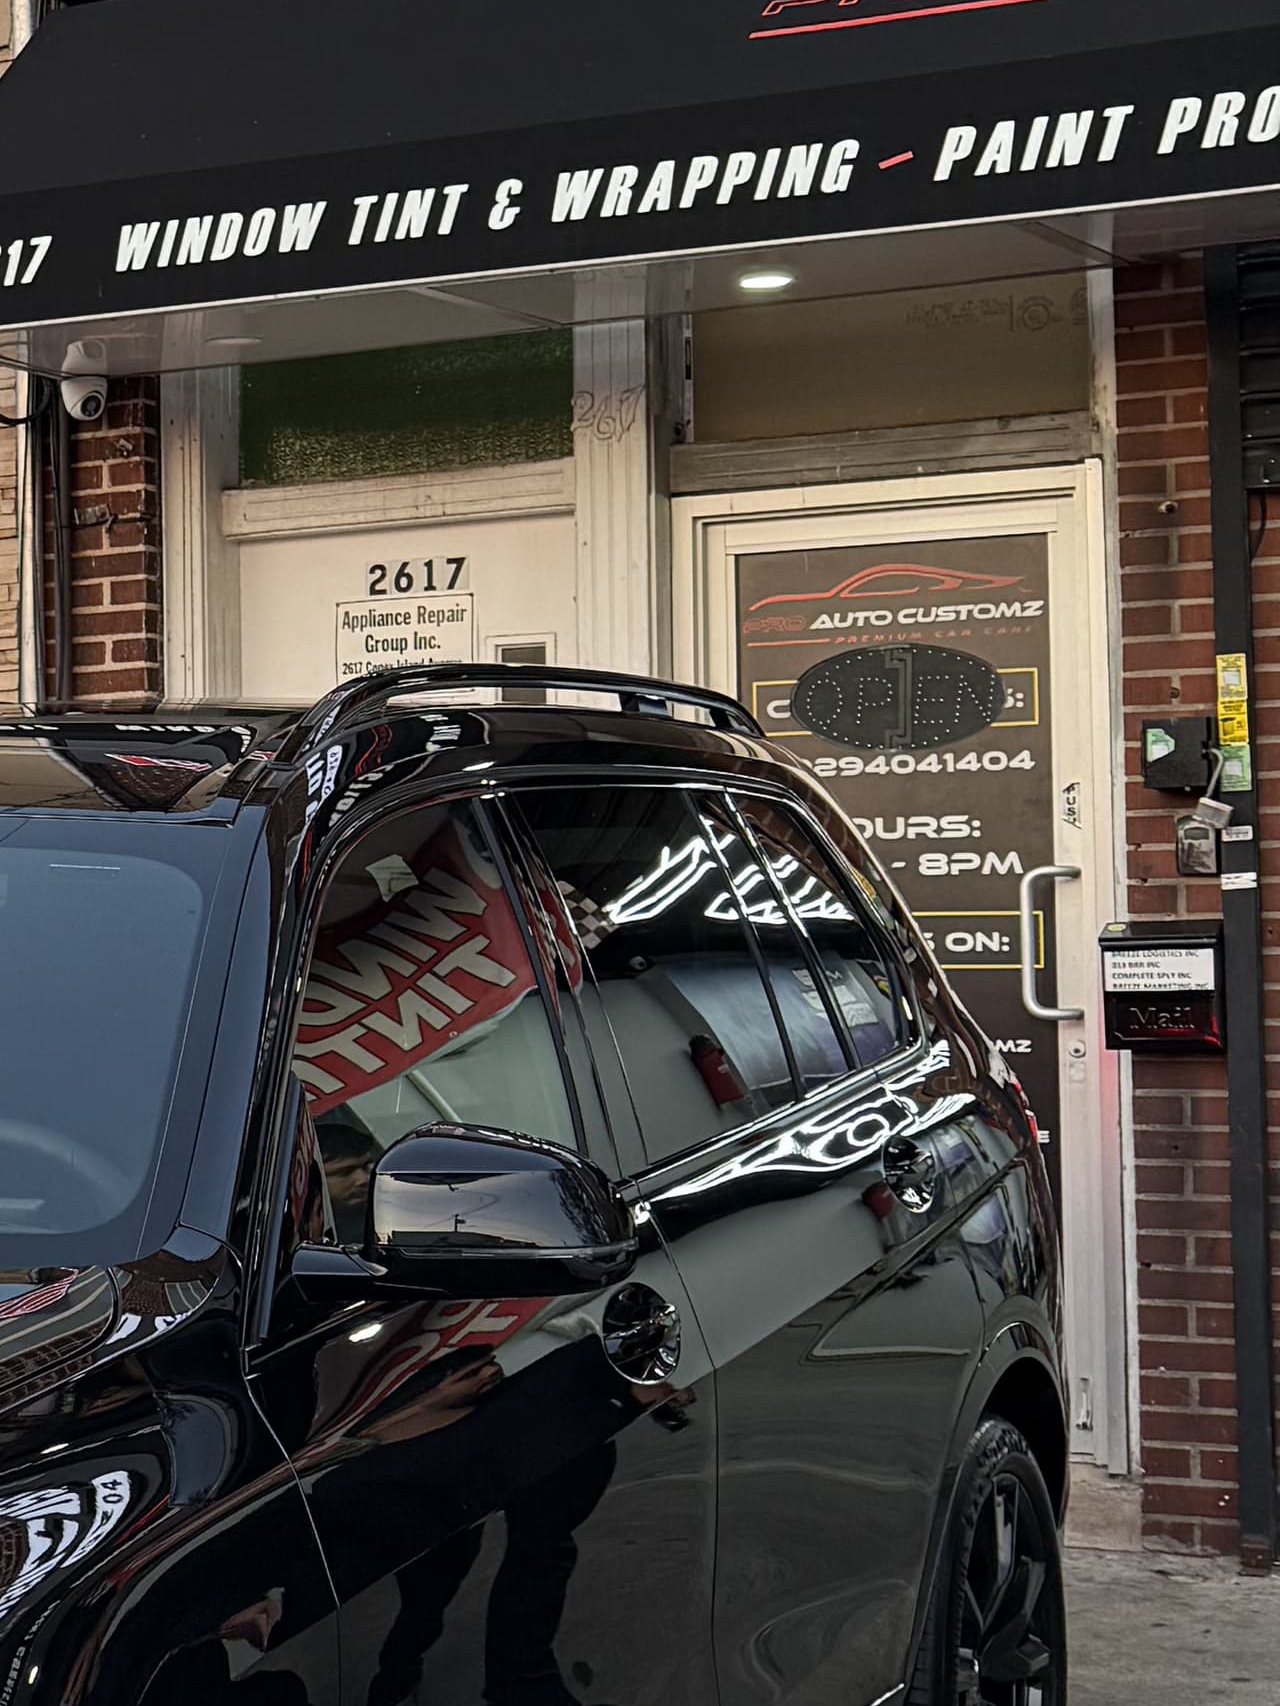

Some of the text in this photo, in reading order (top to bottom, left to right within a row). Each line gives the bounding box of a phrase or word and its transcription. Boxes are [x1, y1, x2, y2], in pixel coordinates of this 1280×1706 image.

[115, 201, 328, 272] WINDOW
[347, 183, 468, 246] TINT
[486, 178, 524, 231] &
[551, 139, 860, 223] WRAPPING
[934, 105, 1133, 182] PAINT
[1157, 85, 1280, 156] PRO
[368, 556, 466, 596] 2617
[342, 603, 467, 633] Appliance Repair
[809, 610, 893, 630] AUTO
[897, 600, 1044, 624] CUSTOMZ
[365, 631, 441, 655] Group Inc.
[342, 662, 363, 675] 2617
[806, 673, 995, 726] OPEN
[918, 851, 1024, 876] 8PM
[945, 931, 1010, 953] ON:
[1112, 972, 1154, 980] COMPLETE
[1178, 972, 1192, 980] INC
